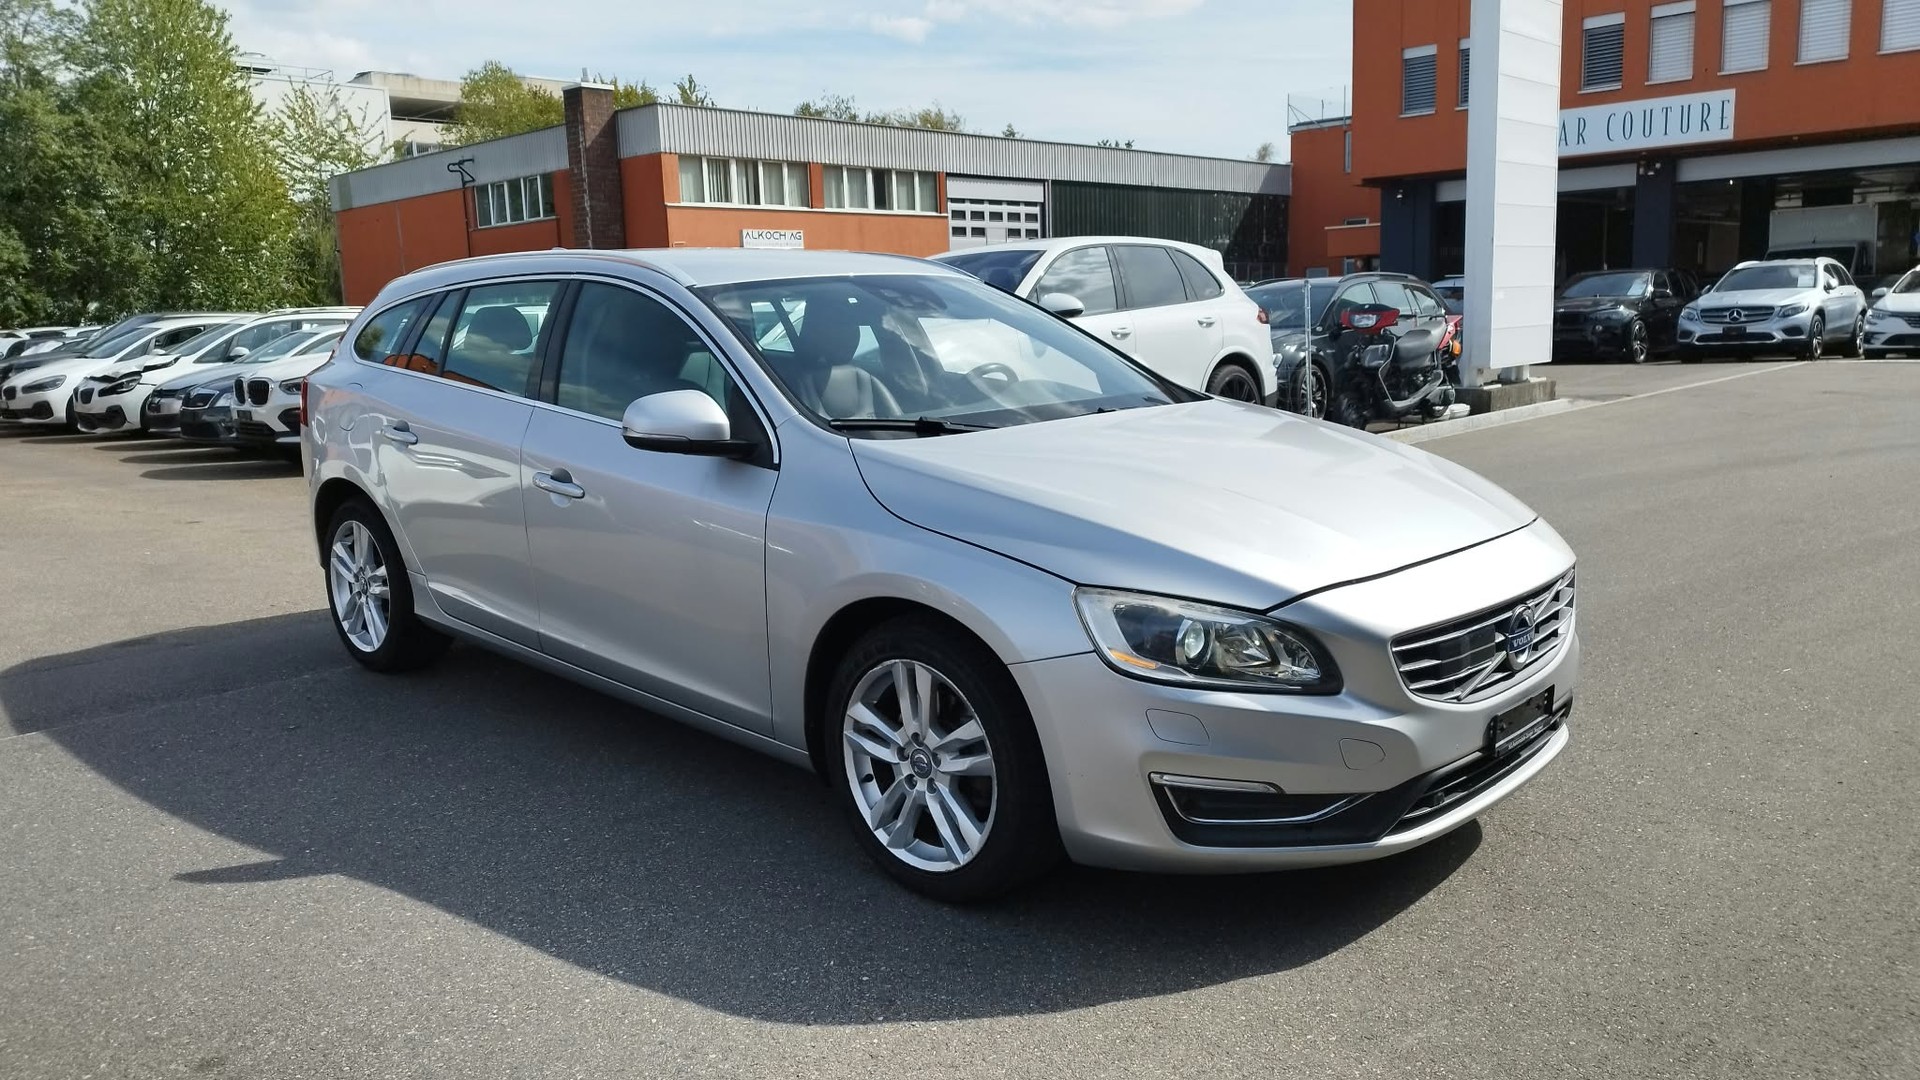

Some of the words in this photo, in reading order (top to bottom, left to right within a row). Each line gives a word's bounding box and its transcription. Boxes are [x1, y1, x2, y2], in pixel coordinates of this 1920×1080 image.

[1558, 116, 1587, 147] AR
[1606, 99, 1730, 142] COUTURE
[745, 231, 786, 240] ALKOCH
[789, 231, 802, 240] AG
[1513, 632, 1531, 648] VOLV
